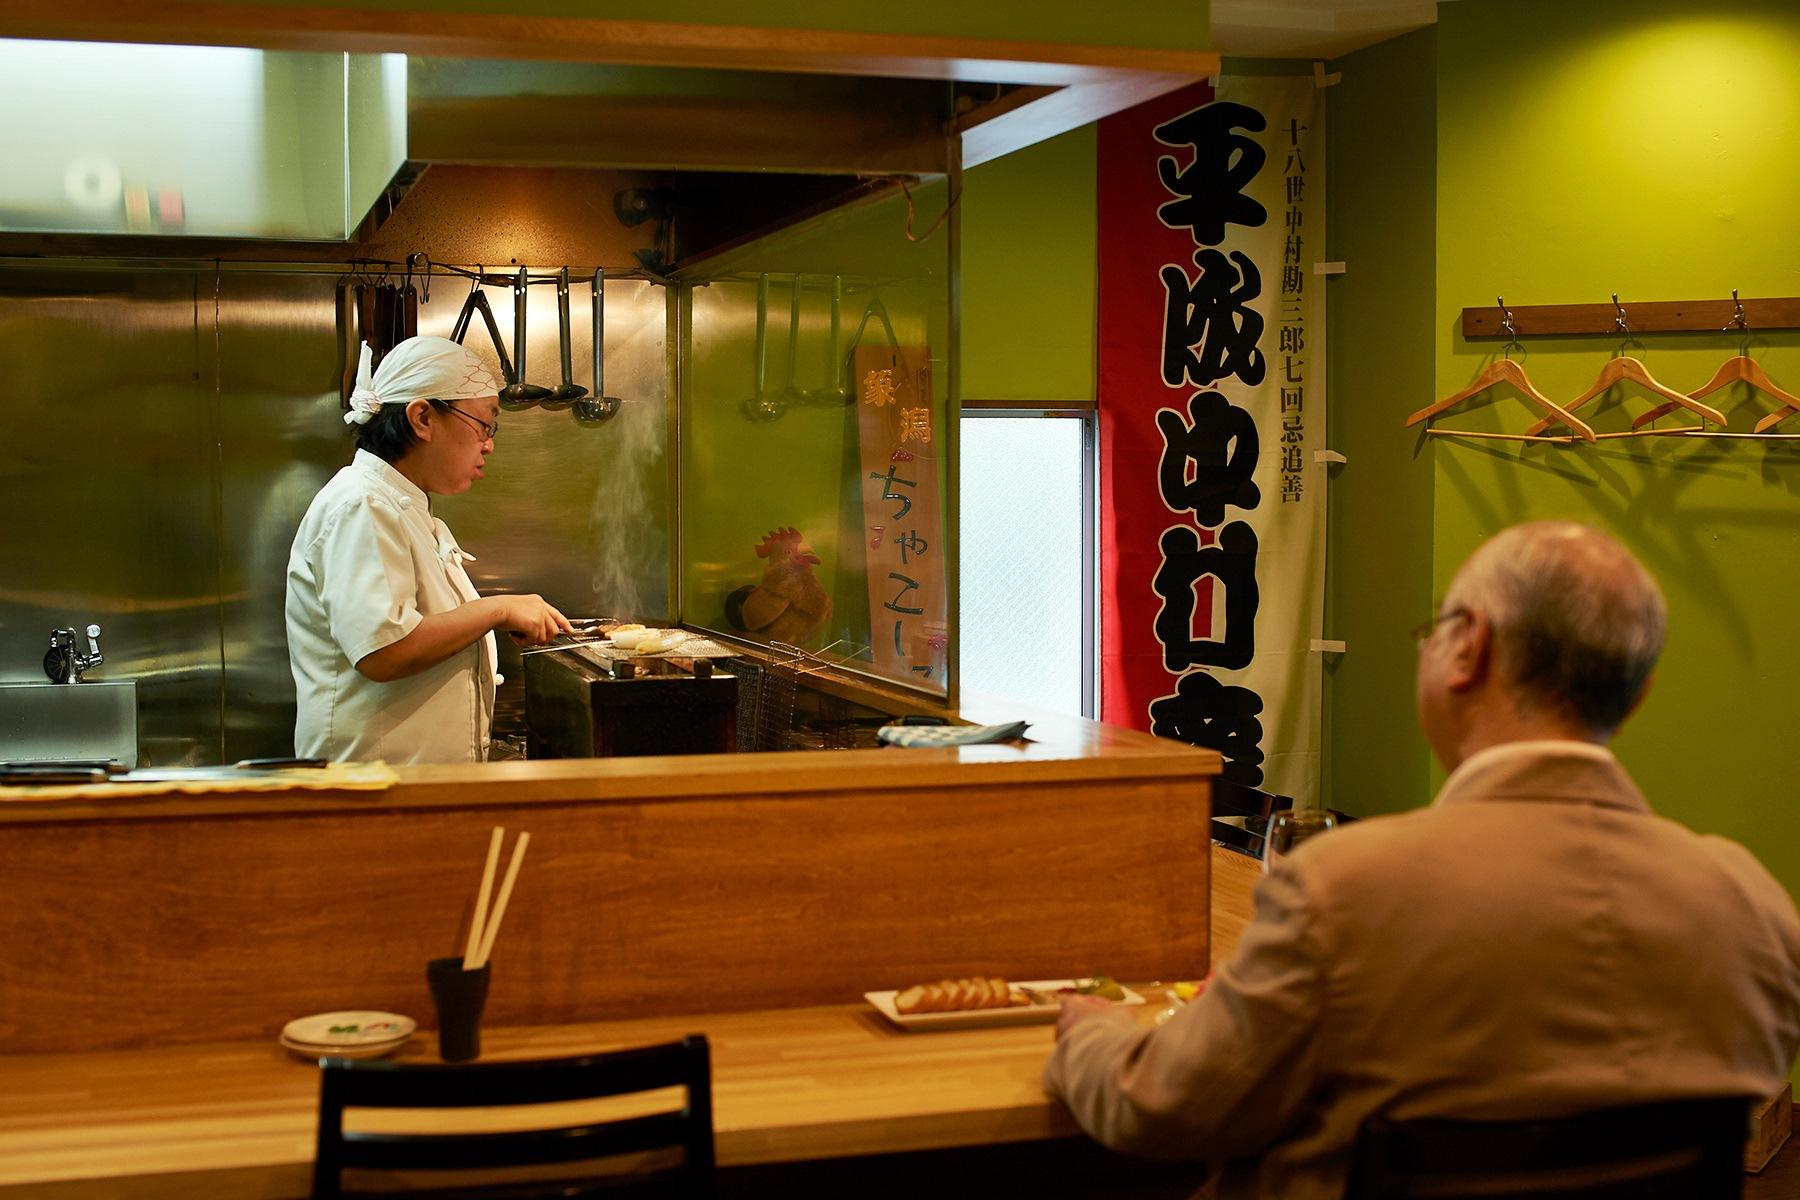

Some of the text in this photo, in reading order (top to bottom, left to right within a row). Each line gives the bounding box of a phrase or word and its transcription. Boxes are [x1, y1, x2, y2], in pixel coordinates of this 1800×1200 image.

[1279, 118, 1308, 503] 十八世中村勘三郎七回忌追善
